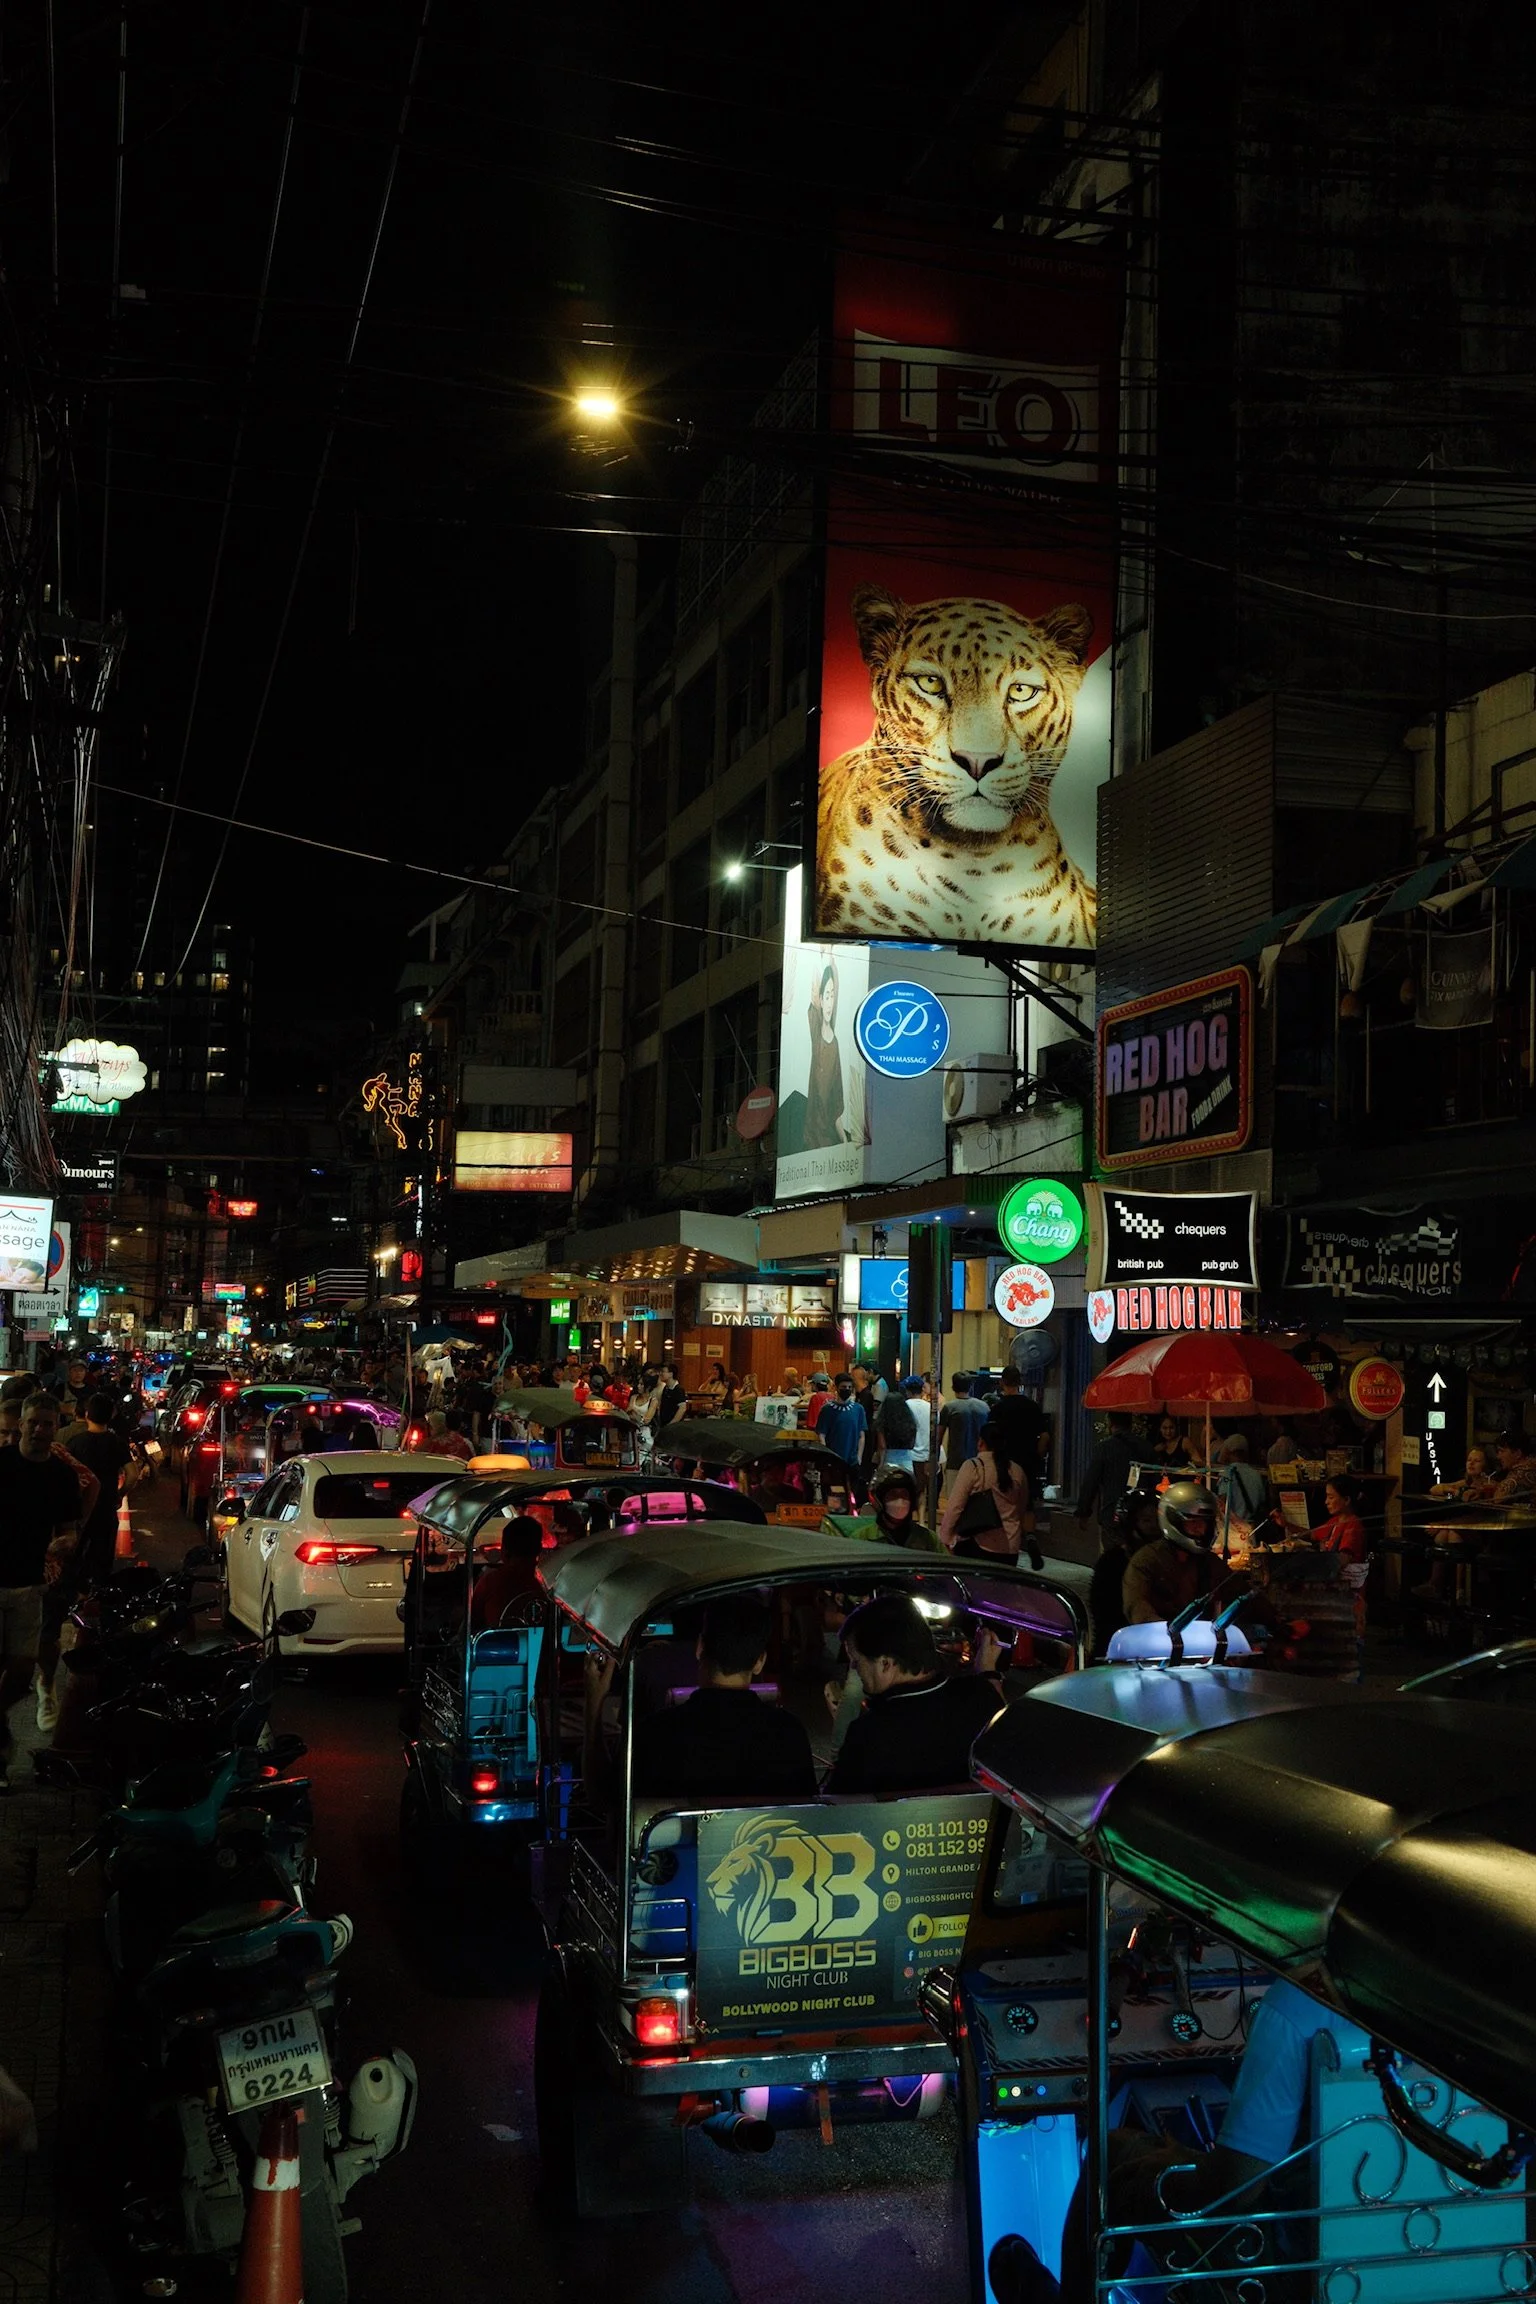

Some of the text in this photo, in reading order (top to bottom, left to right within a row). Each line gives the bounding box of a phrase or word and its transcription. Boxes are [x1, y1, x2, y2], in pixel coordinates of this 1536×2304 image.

[879, 356, 1076, 466] LEO
[879, 1055, 927, 1065] THAI MASSAGE
[1106, 1012, 1229, 1096] RED HOG
[1191, 1098, 1208, 1131] FOOD
[1211, 1073, 1234, 1108] DRINK
[1139, 1086, 1189, 1143] BAR
[60, 1159, 115, 1179] umours
[777, 1156, 859, 1183] Traditional Thai Massage
[1012, 1215, 1072, 1243] Chang
[1175, 1221, 1227, 1238] chequers
[0, 1234, 45, 1251] sage
[1016, 1267, 1032, 1276] HOG
[1117, 1258, 1164, 1271] british pub
[1201, 1260, 1240, 1272] pub grub
[1365, 1259, 1462, 1293] chequers
[18, 1299, 61, 1311] ตลอดเวลา
[1116, 1286, 1152, 1331] RED
[1155, 1285, 1196, 1330] HOG
[1198, 1286, 1242, 1330] BAR
[711, 1312, 778, 1327] DYNASTY
[782, 1313, 808, 1328] INN
[1425, 1432, 1442, 1485] UPSTAI
[906, 1818, 990, 1839] 081 101 99
[906, 1841, 935, 1858] 081
[938, 1839, 965, 1857] 152
[905, 1866, 937, 1877] HILTON
[940, 1863, 975, 1874] GRANDE
[738, 1939, 877, 1976] BIGBOSS
[918, 1950, 932, 1959] BIG
[934, 1949, 953, 1958] BOSS
[766, 1970, 849, 1990] NIGHT CLUB
[722, 1994, 877, 2018] BOLLYWOOD NIGHT CLUB
[228, 2041, 319, 2079] กรุงเทพมหานคร
[245, 2063, 313, 2101] 6224
